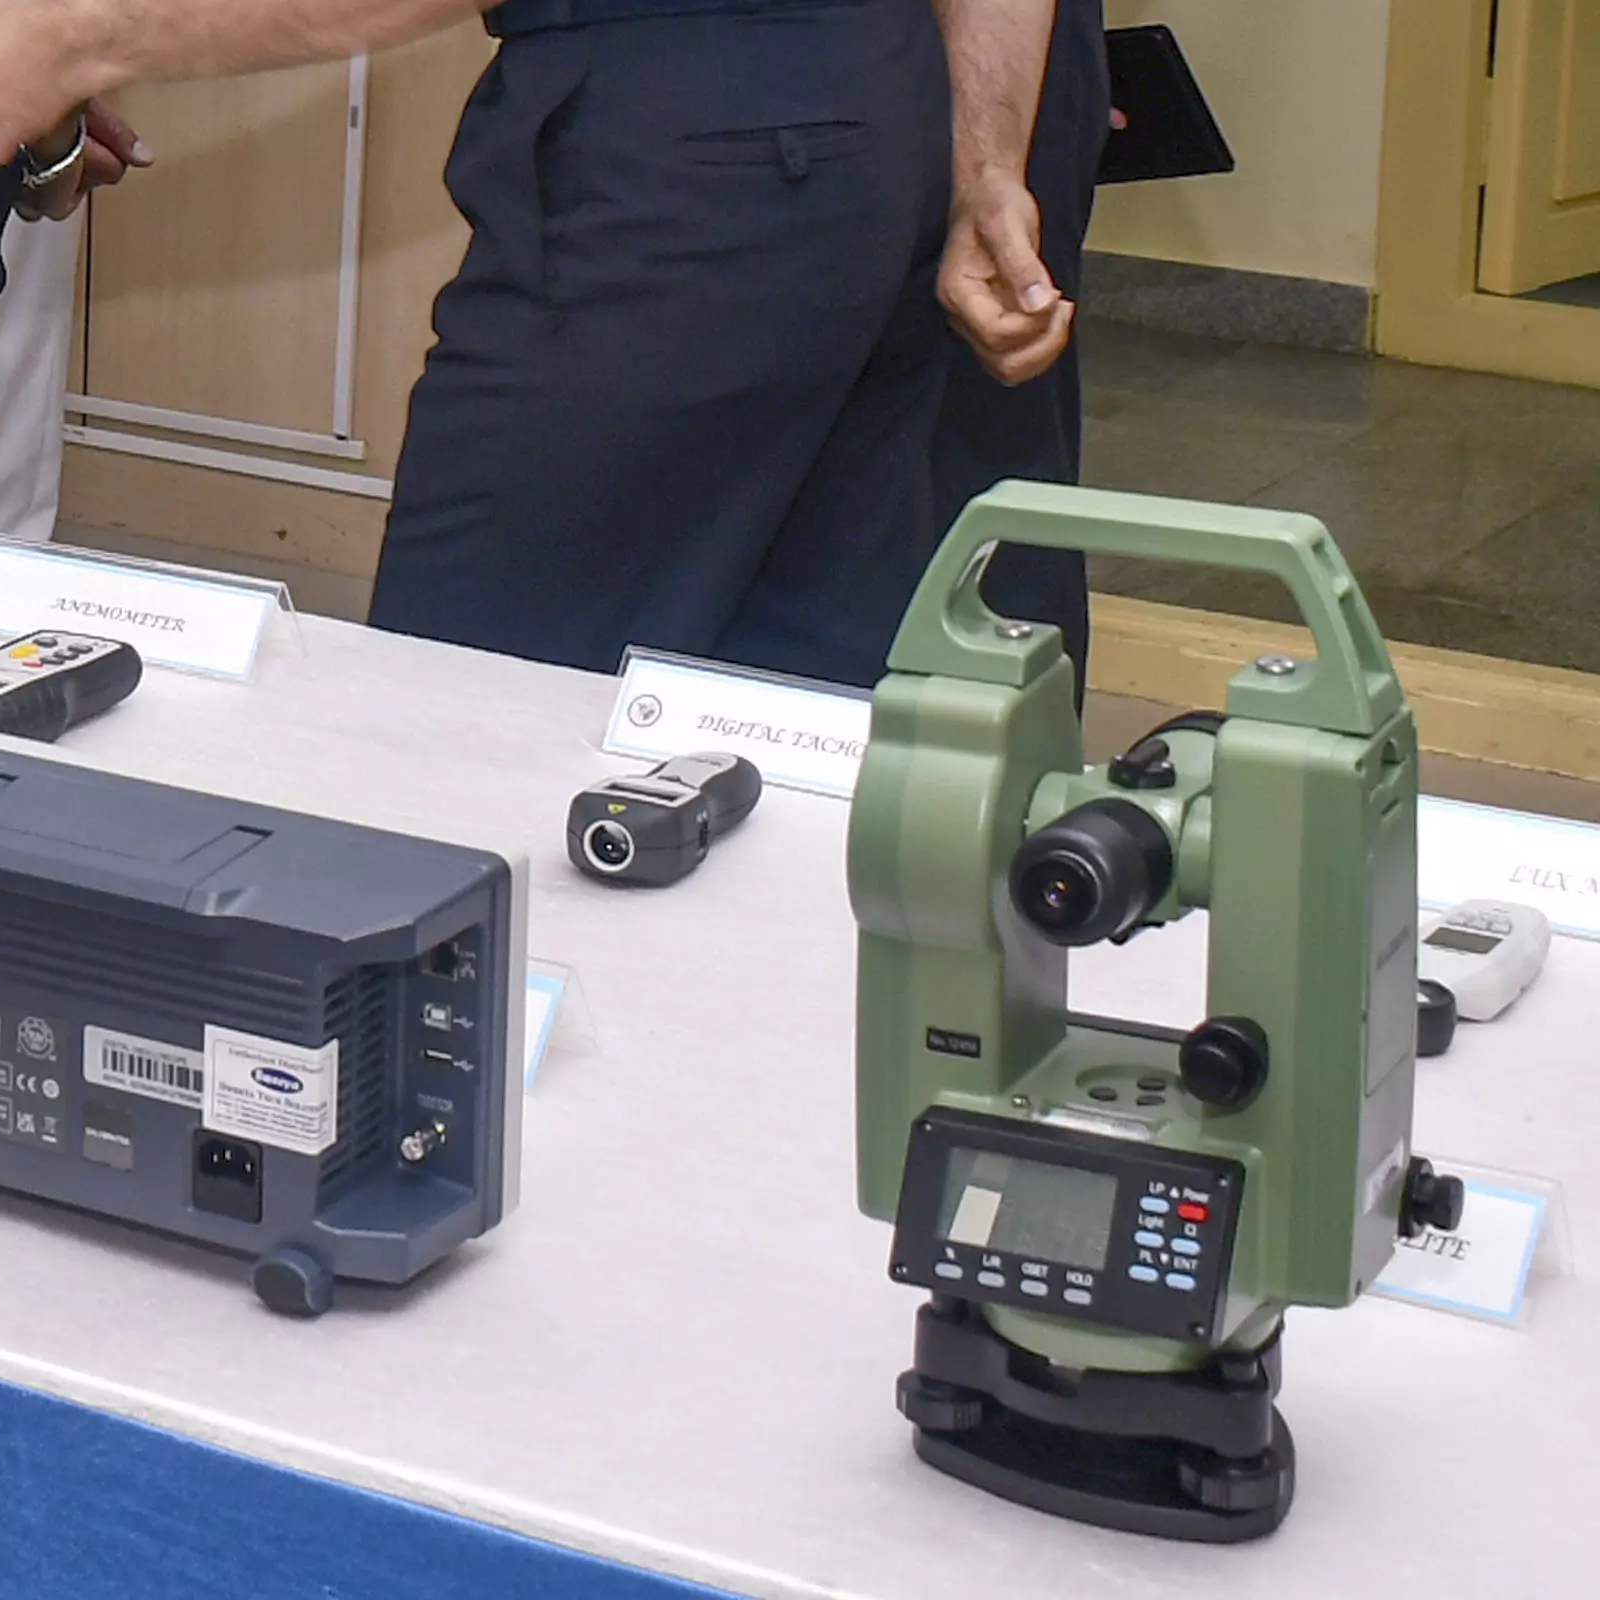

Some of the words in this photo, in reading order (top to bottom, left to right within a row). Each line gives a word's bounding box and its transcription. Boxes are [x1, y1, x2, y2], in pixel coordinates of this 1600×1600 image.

[50, 596, 187, 634] ANEMOMETER
[697, 714, 788, 744] DIGITAL
[1508, 864, 1574, 892] LUX
[1173, 1256, 1199, 1270] ENT
[1066, 1270, 1094, 1287] HOLD
